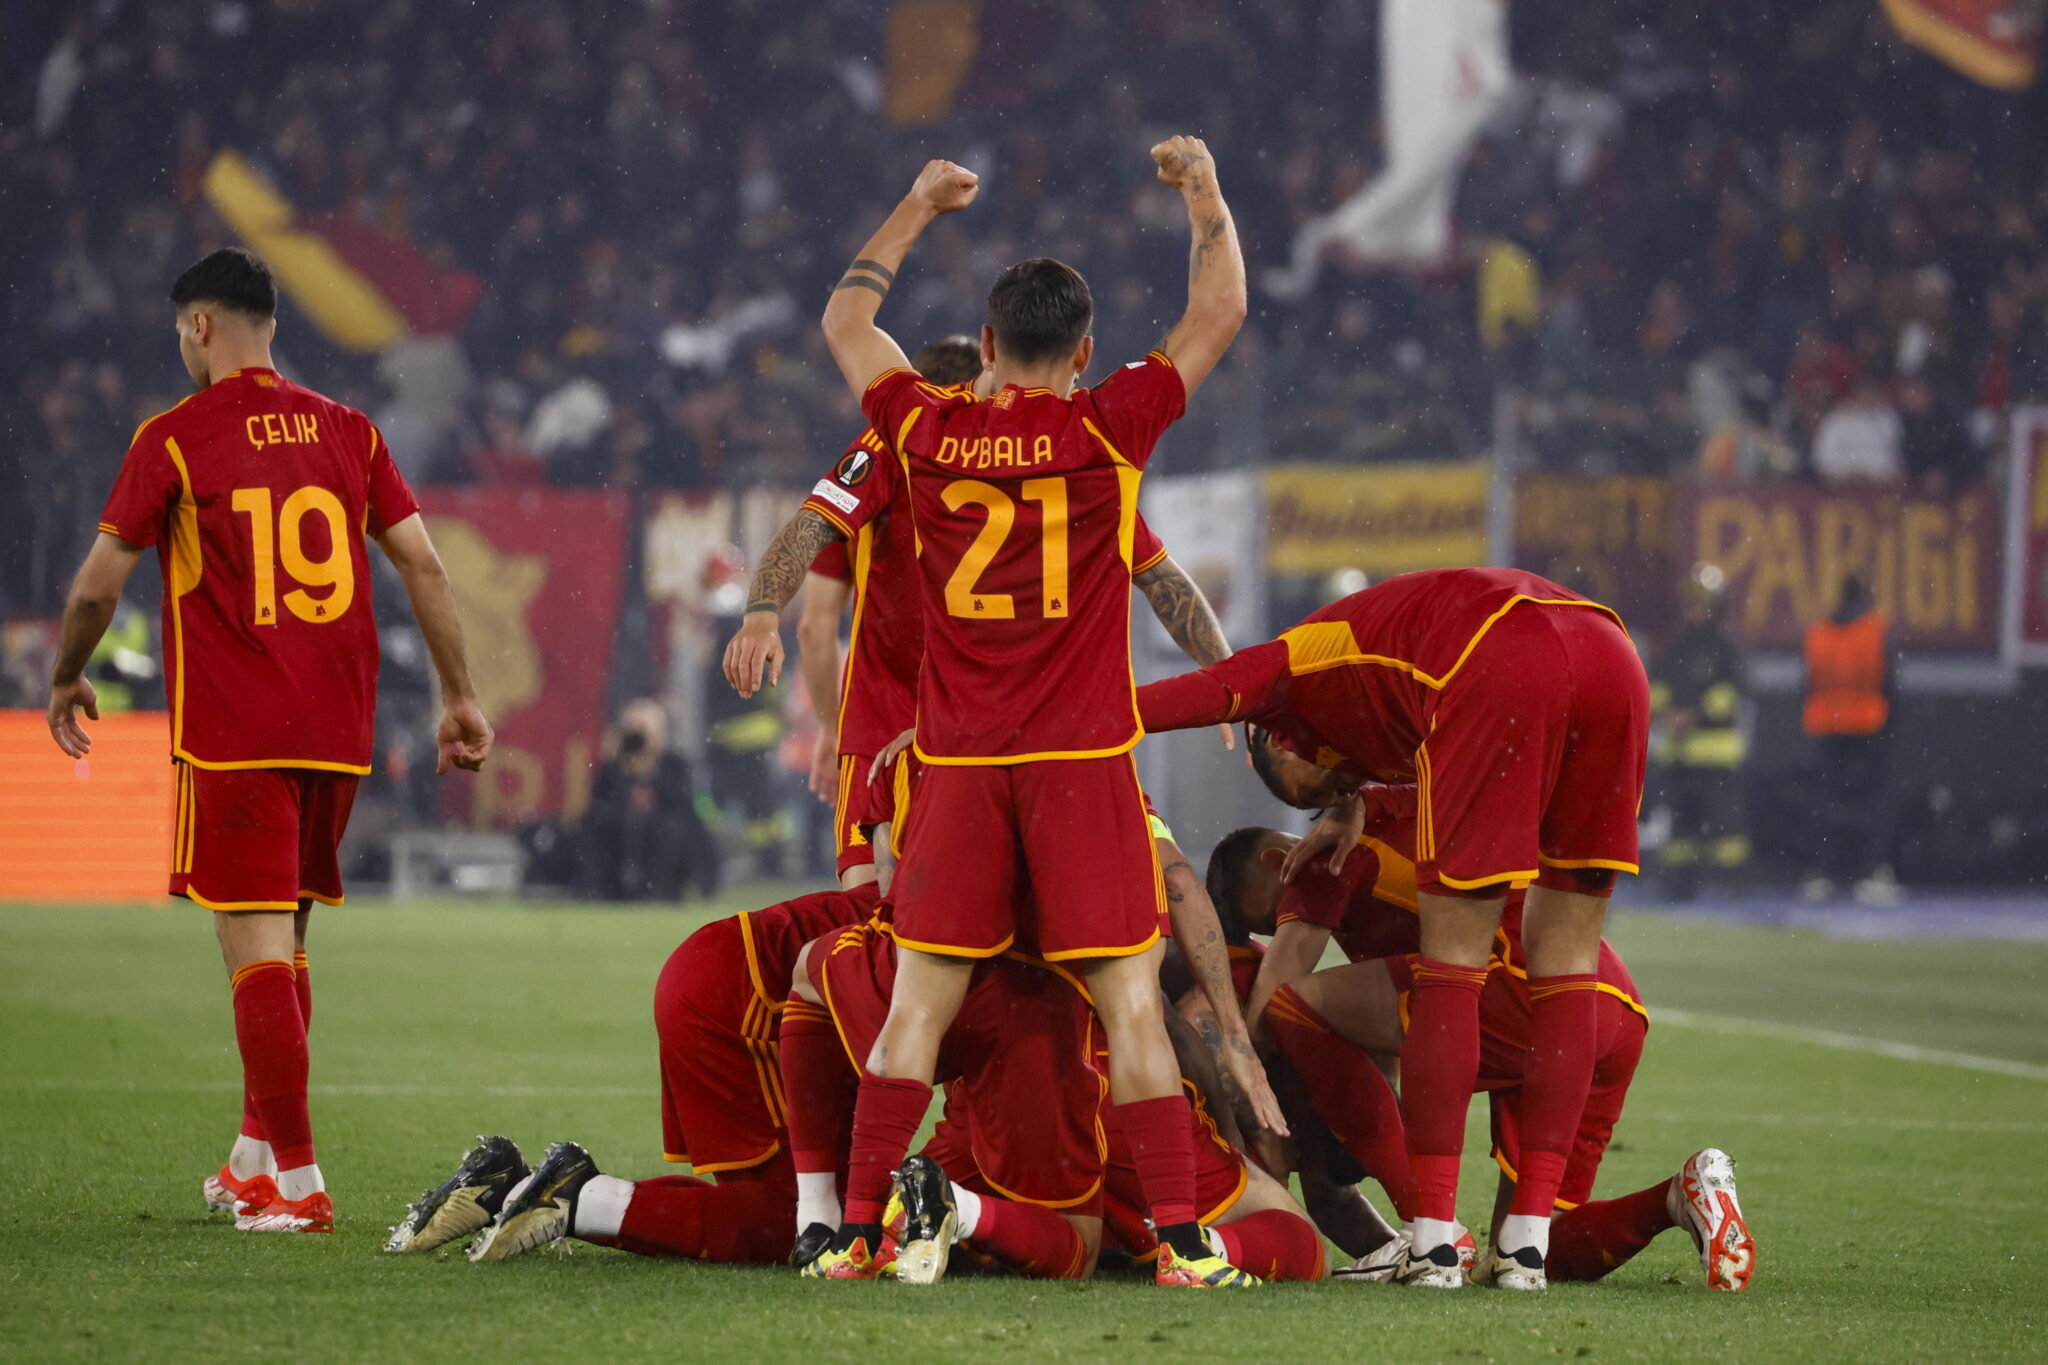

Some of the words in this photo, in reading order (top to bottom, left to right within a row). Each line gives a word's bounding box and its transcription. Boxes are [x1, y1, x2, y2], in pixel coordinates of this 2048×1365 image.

[246, 413, 319, 450] ÇELIK
[936, 435, 1052, 468] DYBALA
[232, 485, 354, 625] 19
[940, 477, 1069, 619] 21
